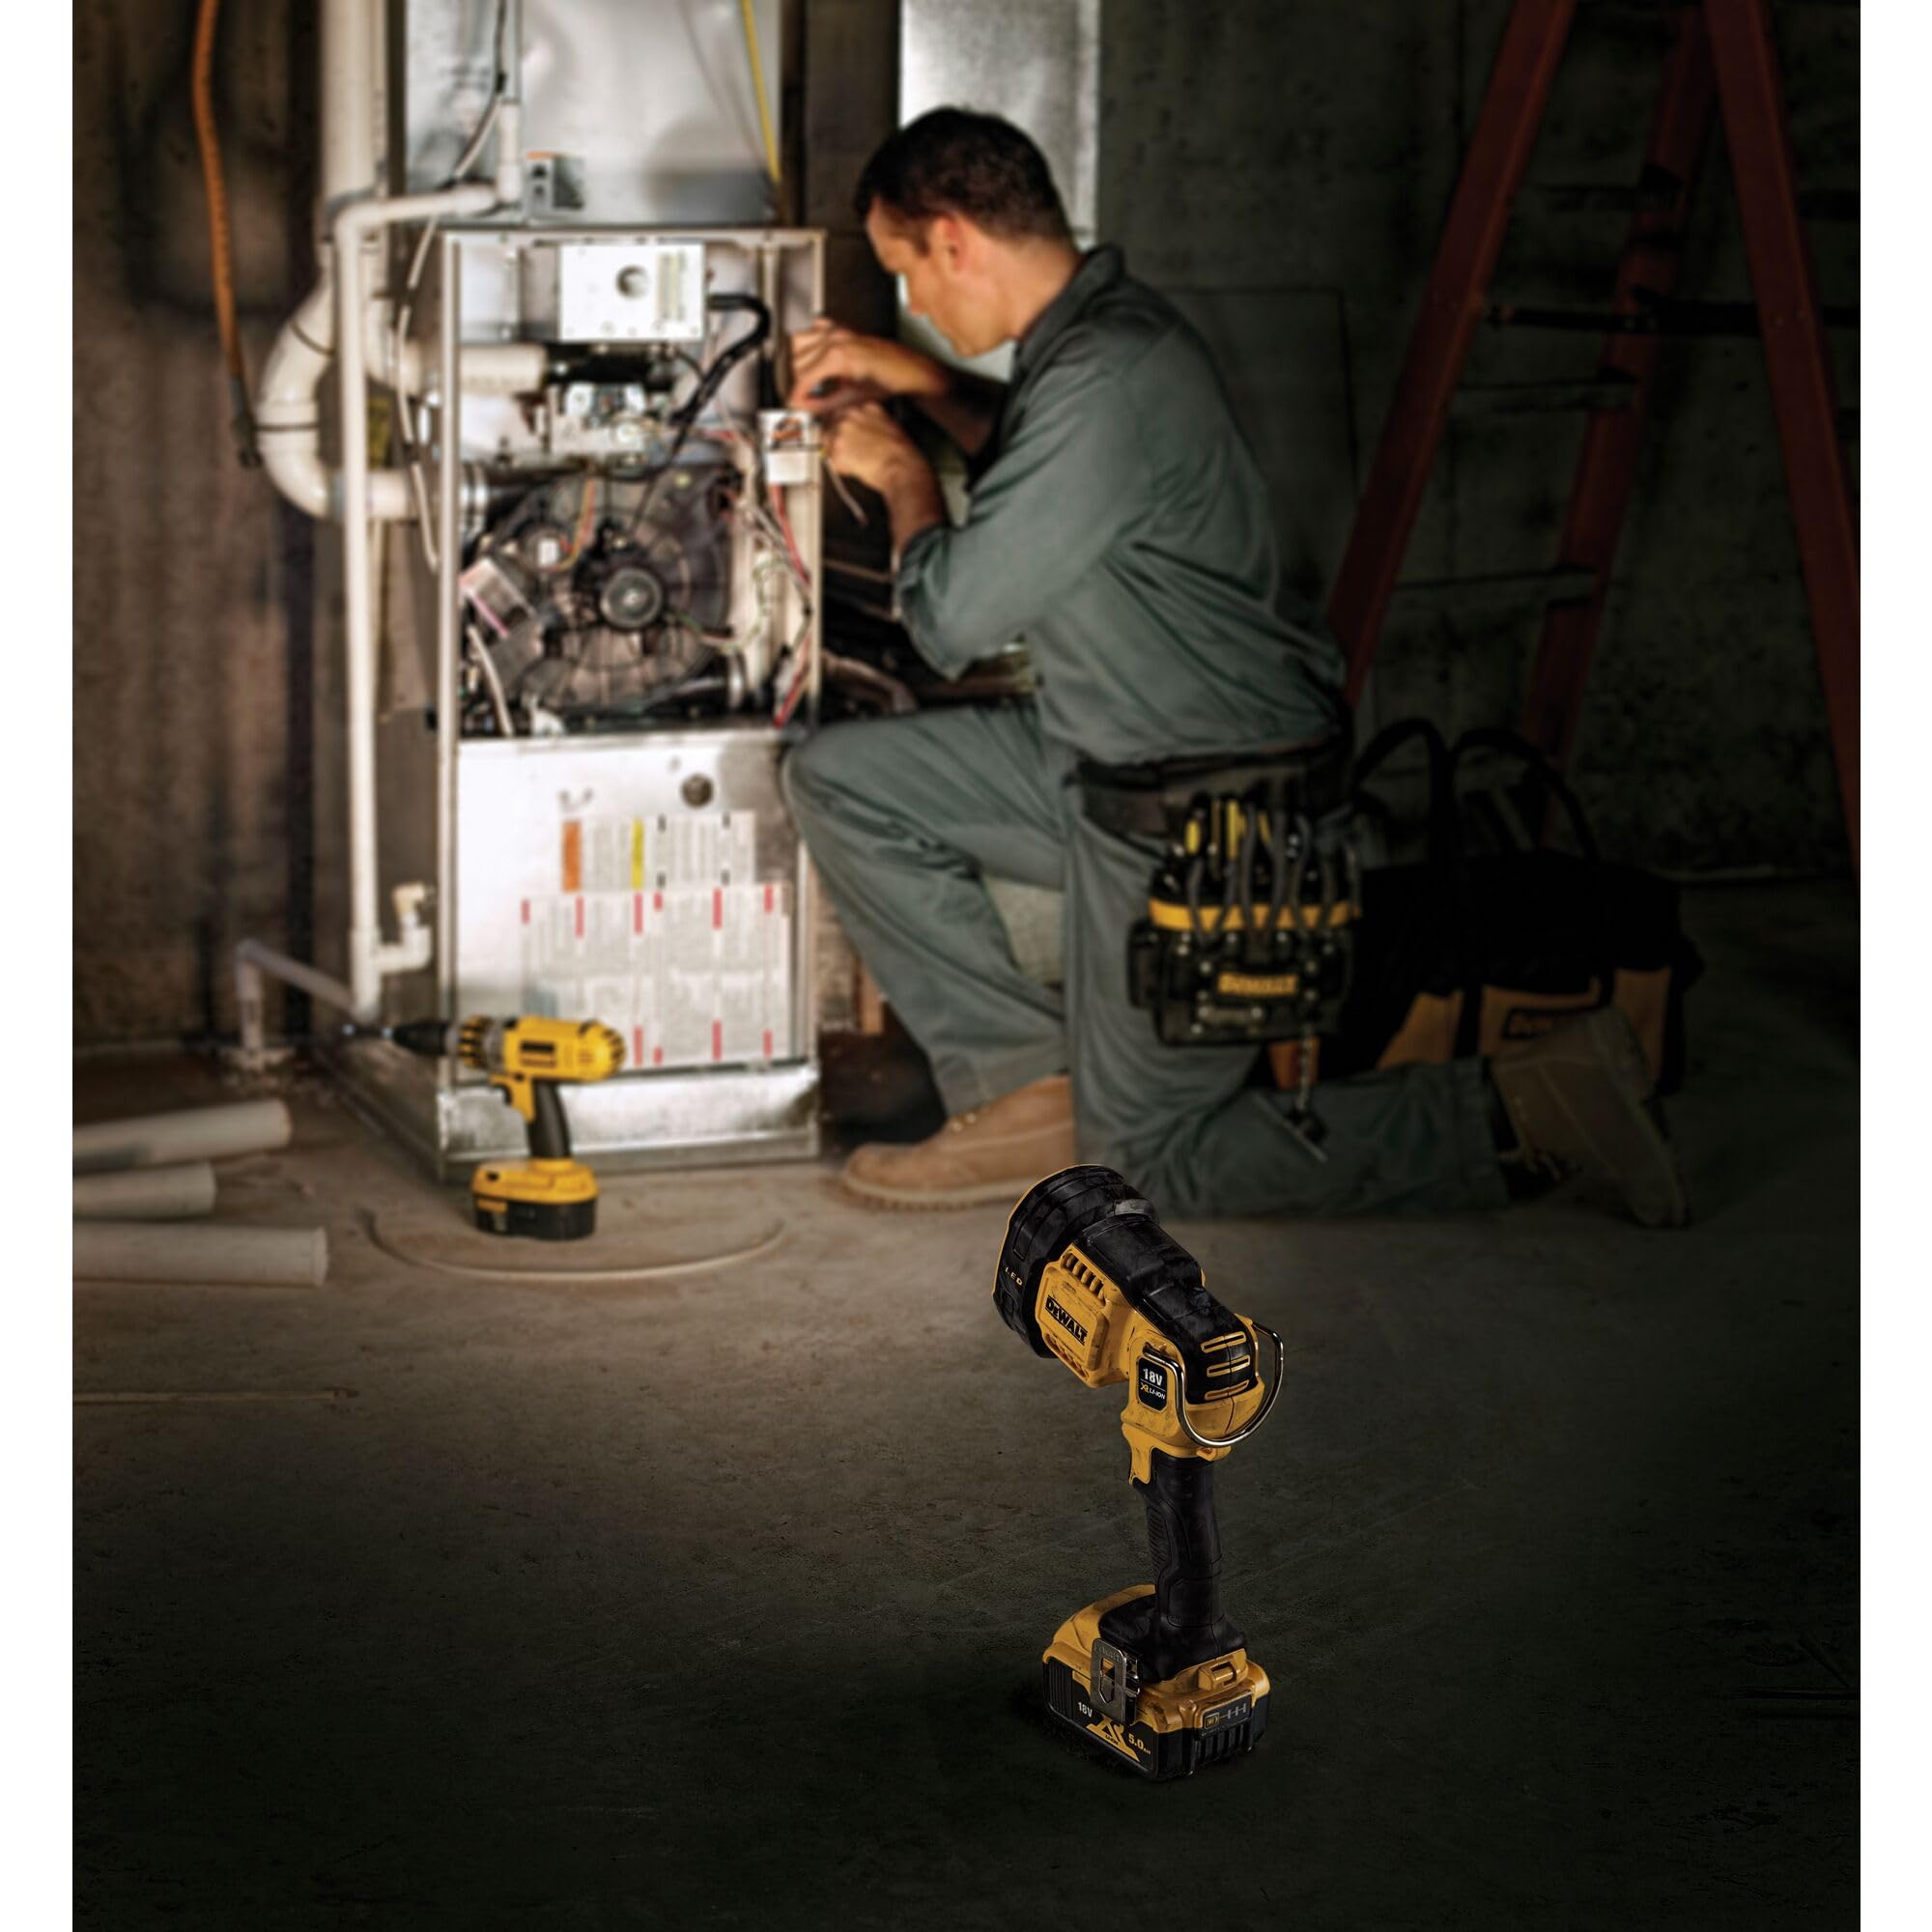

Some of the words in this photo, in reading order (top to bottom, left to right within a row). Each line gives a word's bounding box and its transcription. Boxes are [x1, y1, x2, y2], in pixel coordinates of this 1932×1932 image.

[1005, 1266, 1023, 1286] LED
[1045, 1295, 1088, 1345] DEWALT
[1143, 1368, 1163, 1386] 18V
[1077, 1701, 1093, 1718] 18V
